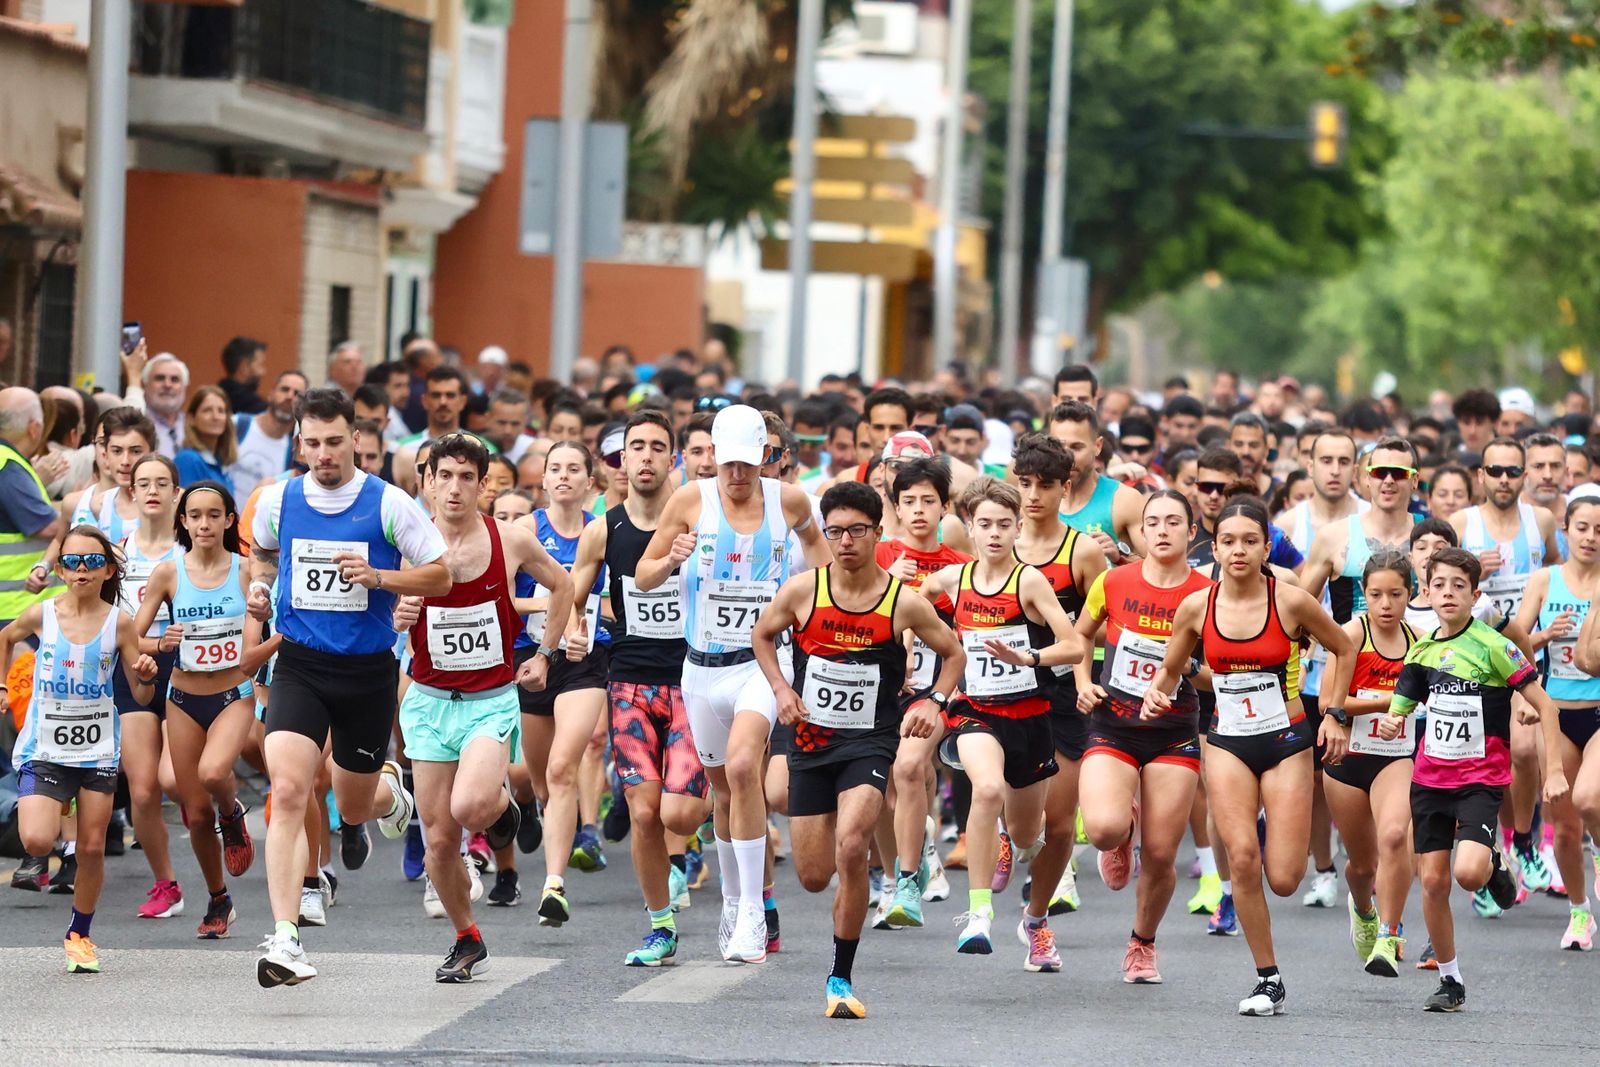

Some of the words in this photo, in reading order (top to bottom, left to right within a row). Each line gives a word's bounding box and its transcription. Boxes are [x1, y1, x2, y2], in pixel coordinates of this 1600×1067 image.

[306, 568, 354, 593] 879
[177, 603, 225, 619] nerja
[637, 601, 681, 622] 565
[716, 606, 761, 628] 571
[820, 619, 875, 637] Málaga
[194, 641, 238, 665] 298
[443, 631, 491, 655] 504
[816, 687, 865, 712] 926
[1242, 697, 1257, 719] 1
[54, 724, 101, 746] 680
[1367, 718, 1407, 739] 11
[1434, 720, 1472, 742] 674
